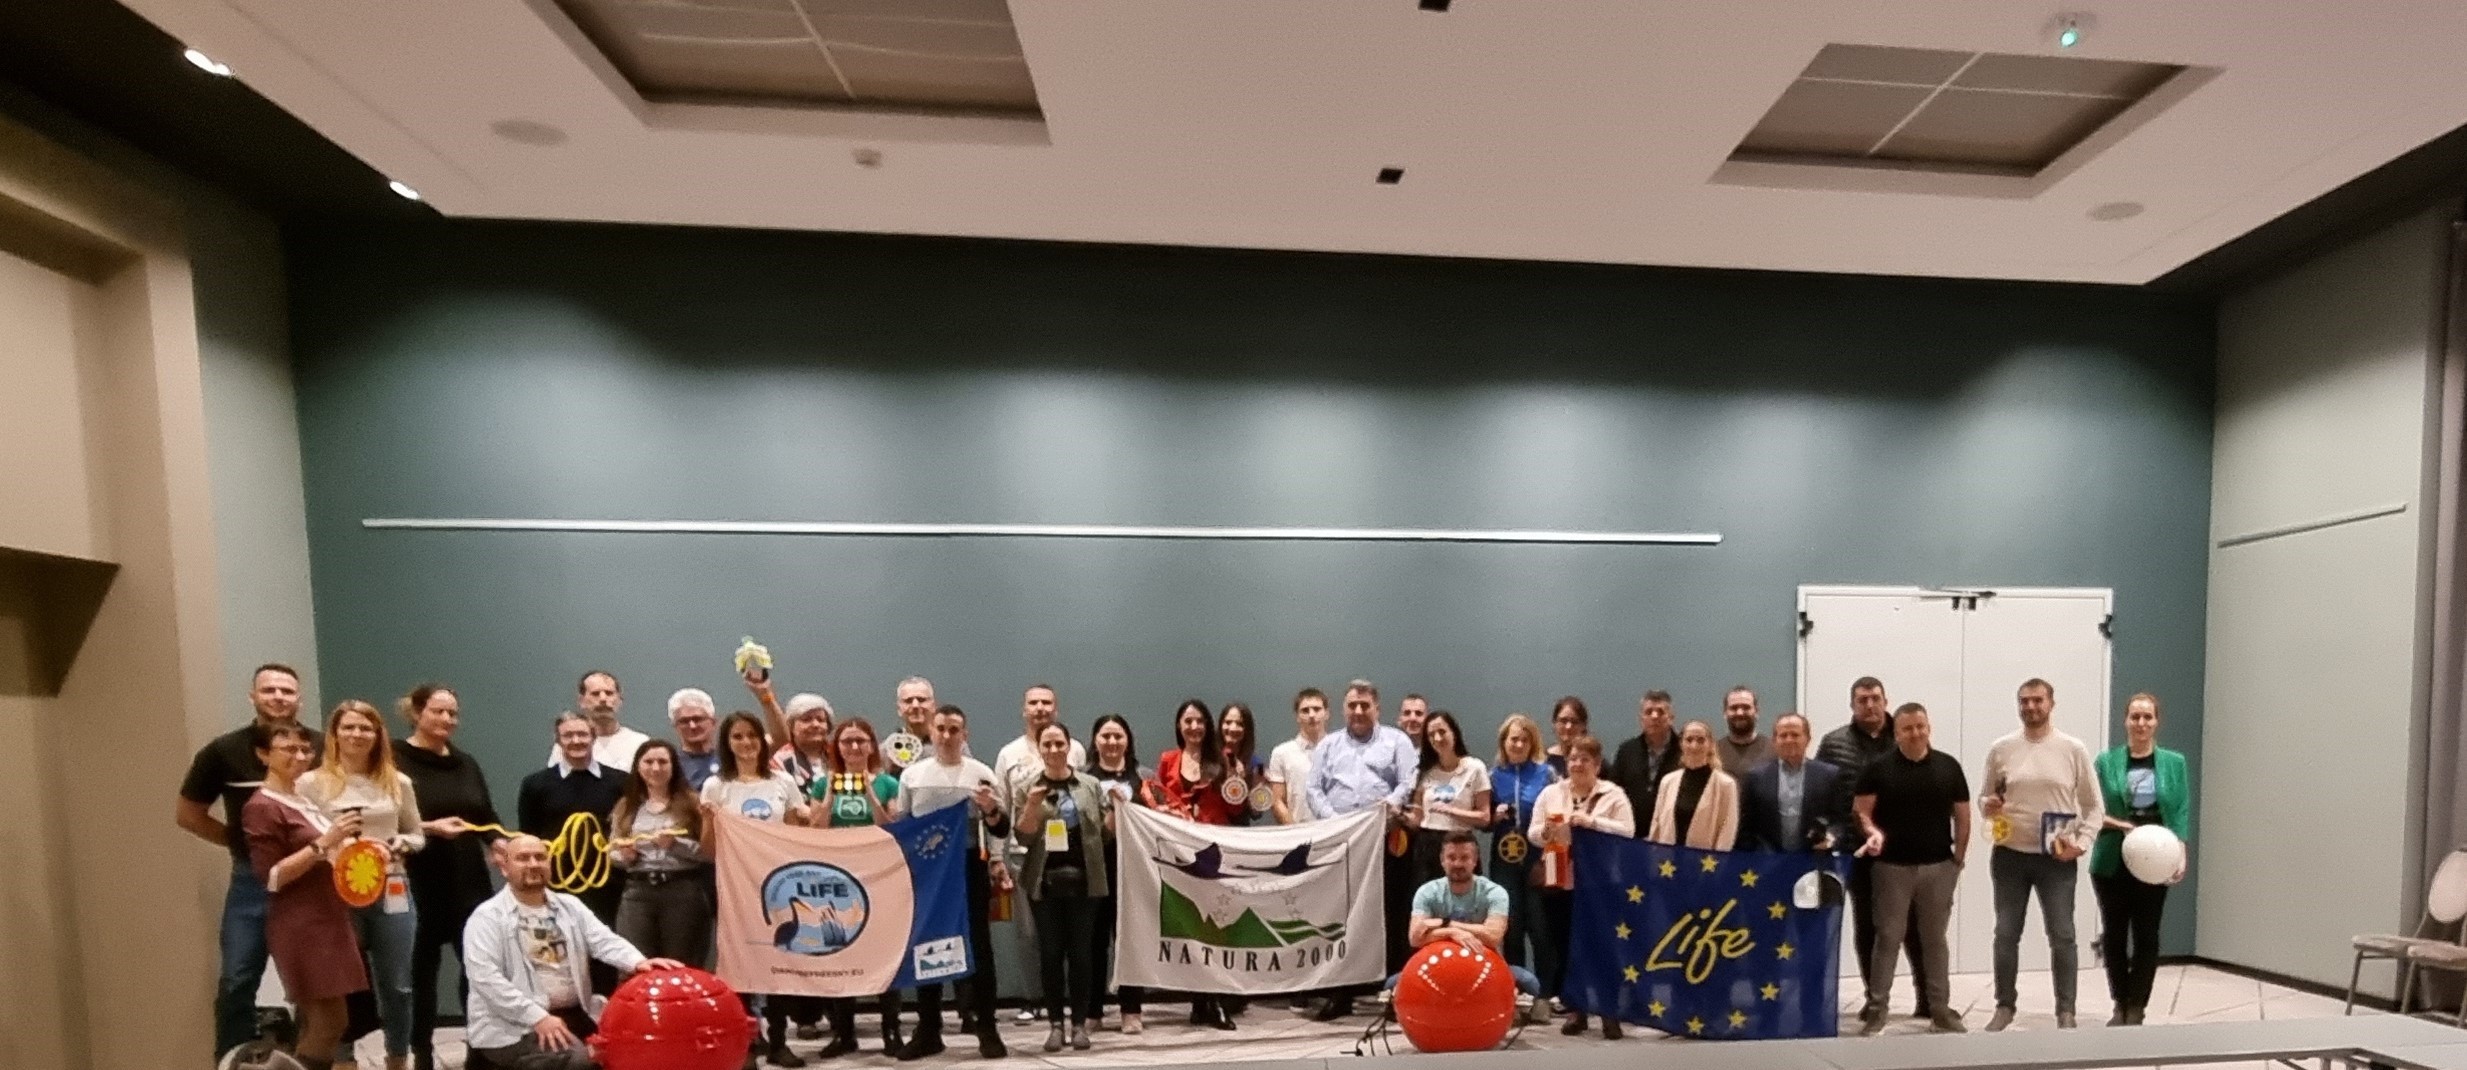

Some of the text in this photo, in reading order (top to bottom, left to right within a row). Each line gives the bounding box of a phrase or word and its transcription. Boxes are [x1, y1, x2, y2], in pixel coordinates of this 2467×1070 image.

[797, 882, 849, 898] LIFE
[1158, 940, 1346, 971] NATURA 2000
[1646, 899, 1755, 984] Life
